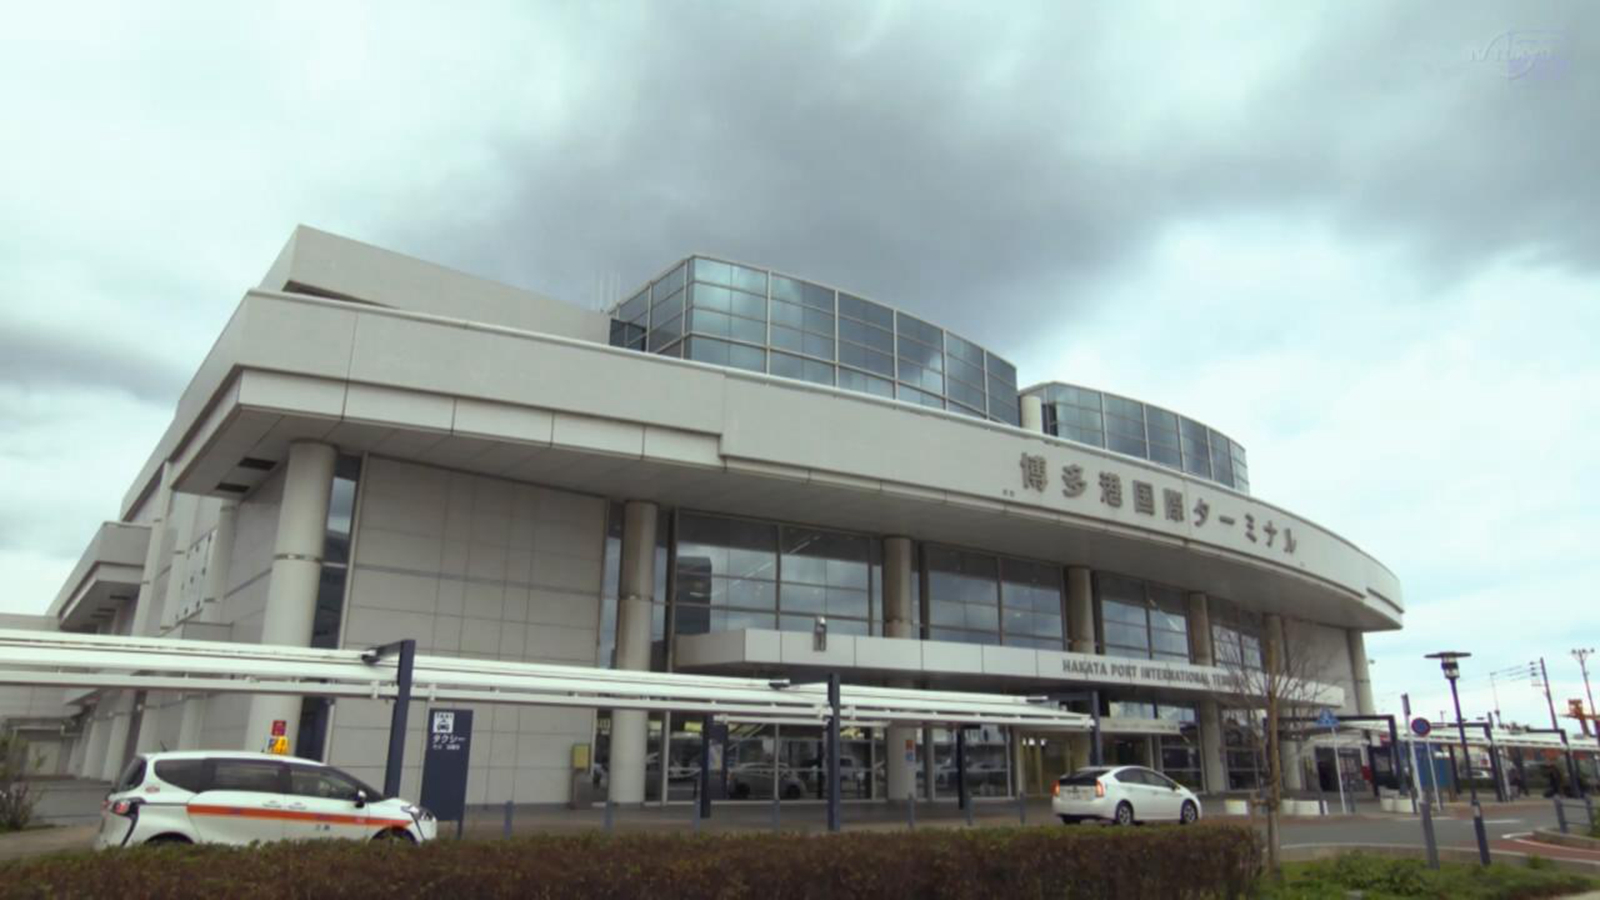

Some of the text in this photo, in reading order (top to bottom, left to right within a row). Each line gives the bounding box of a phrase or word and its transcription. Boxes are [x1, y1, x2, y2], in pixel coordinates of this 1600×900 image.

[1020, 452, 1297, 555] 博多港国際ターミナル
[1062, 659, 1108, 676] HAKATA
[1111, 664, 1137, 678] PORT
[1140, 667, 1210, 688] INTERNATIONAL
[432, 734, 467, 744] タクシー
